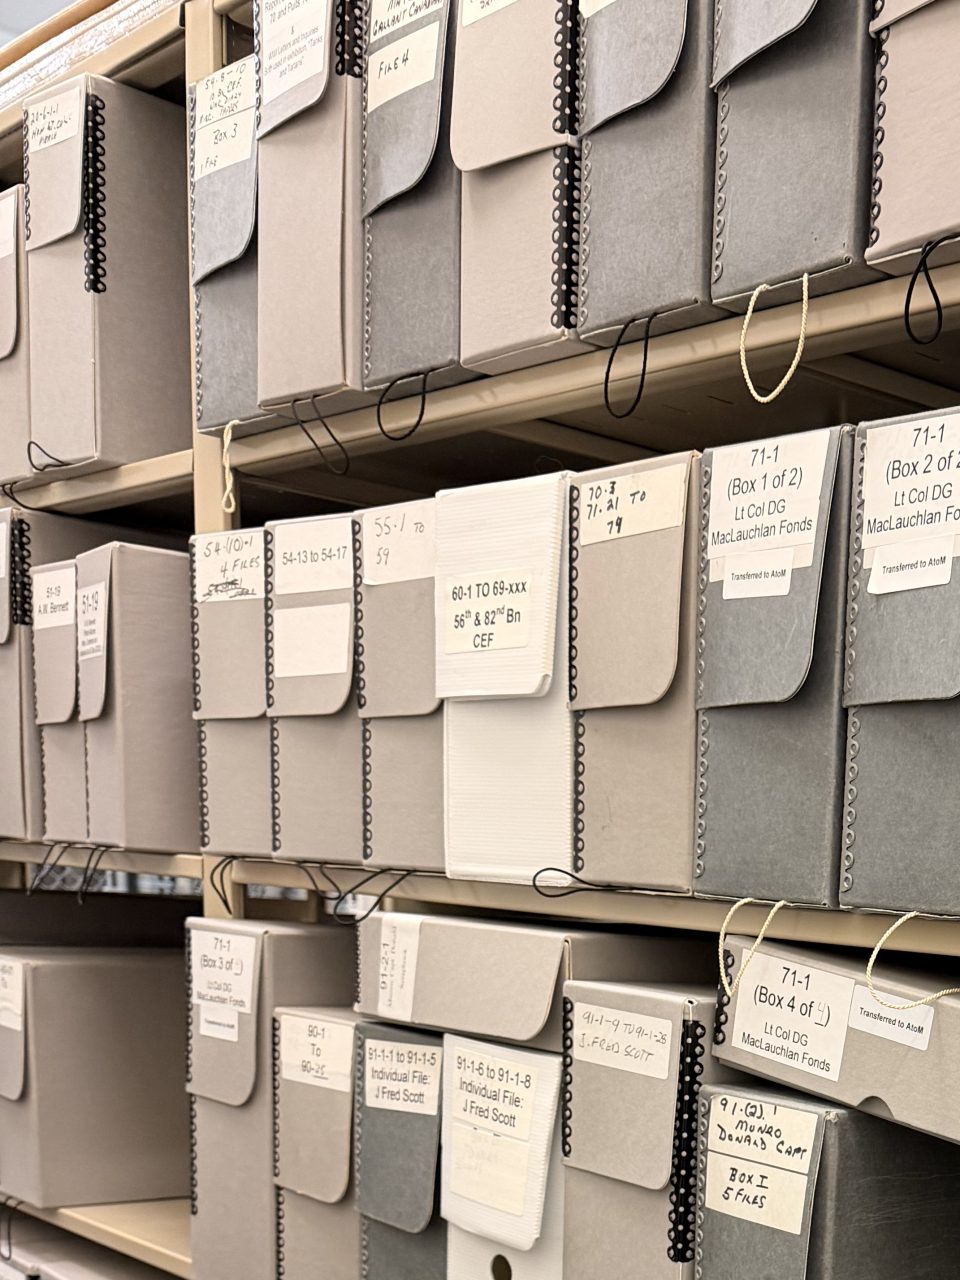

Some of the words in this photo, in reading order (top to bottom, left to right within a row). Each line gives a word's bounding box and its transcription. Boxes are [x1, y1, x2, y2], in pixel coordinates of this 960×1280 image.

[379, 57, 398, 79] FILE
[402, 48, 409, 66] 4
[231, 123, 238, 138] 3
[913, 424, 945, 447] 71-1
[751, 444, 780, 466] 71-1
[886, 460, 918, 484] (Box
[923, 457, 932, 474] 2
[937, 453, 953, 471] of
[727, 477, 756, 500] (Box
[762, 474, 768, 491] 1
[772, 471, 787, 490] of
[789, 467, 803, 490] 2)
[894, 490, 905, 506] Lt
[908, 486, 928, 504] Col
[932, 483, 952, 501] DG
[735, 507, 745, 520] Lt
[747, 502, 765, 519] Col
[767, 499, 786, 516] DG
[711, 525, 776, 546] MacLauchlan
[779, 517, 812, 537] Fonds
[867, 511, 941, 535] MacLauchlan
[221, 562, 228, 578] 4
[232, 556, 261, 573] FILES
[282, 550, 308, 565] 54-13
[310, 551, 318, 563] to
[321, 547, 347, 561] 54-17
[377, 549, 389, 566] 59
[882, 563, 918, 575] Transferred
[919, 560, 926, 568] to
[928, 556, 946, 567] AtoM
[731, 571, 762, 581] Transferred
[763, 570, 770, 579] to
[771, 569, 786, 577] AtoM
[452, 584, 472, 601] 60-1
[476, 583, 490, 597] TO
[492, 580, 527, 596] 69-xxx
[82, 590, 99, 615] 51-19
[454, 609, 472, 629] 56th
[474, 612, 481, 626] &
[484, 605, 505, 625] 82nd
[506, 608, 521, 624] Bn
[473, 632, 494, 648] CEF
[213, 937, 230, 952] 71-1
[782, 966, 811, 990] 71-1
[754, 984, 784, 1010] (Box
[787, 996, 796, 1012] 4
[799, 1001, 815, 1017] of
[308, 1025, 325, 1038] 90-1
[859, 1007, 897, 1026] Transferred
[897, 1020, 905, 1028] to
[905, 1021, 924, 1035] AtoM
[764, 1022, 774, 1035] Lt
[775, 1025, 789, 1040] Col
[792, 1031, 808, 1047] DG
[311, 1044, 321, 1056] To
[368, 1048, 394, 1062] 91-1-1
[397, 1052, 405, 1063] to
[407, 1052, 437, 1066] 91-1-5
[742, 1032, 800, 1062] MacLauchlan
[802, 1052, 831, 1072] Fonds
[372, 1069, 410, 1084] Individual
[412, 1071, 431, 1085] File:
[457, 1056, 484, 1076] 91-1-6
[486, 1066, 495, 1079] to
[497, 1067, 531, 1088] 91-1-8
[376, 1089, 380, 1099] J
[382, 1089, 400, 1101] Fred
[402, 1091, 425, 1105] Scott
[459, 1077, 500, 1101] Individual
[503, 1090, 523, 1108] File:
[463, 1099, 468, 1112] J
[469, 1103, 489, 1120] Fred
[492, 1109, 517, 1127] Scott
[717, 1123, 767, 1151] DONALD
[735, 1120, 782, 1138] MUNRO
[729, 1167, 754, 1185] BOX
[722, 1186, 734, 1200] 5
[735, 1188, 767, 1208] FILES
